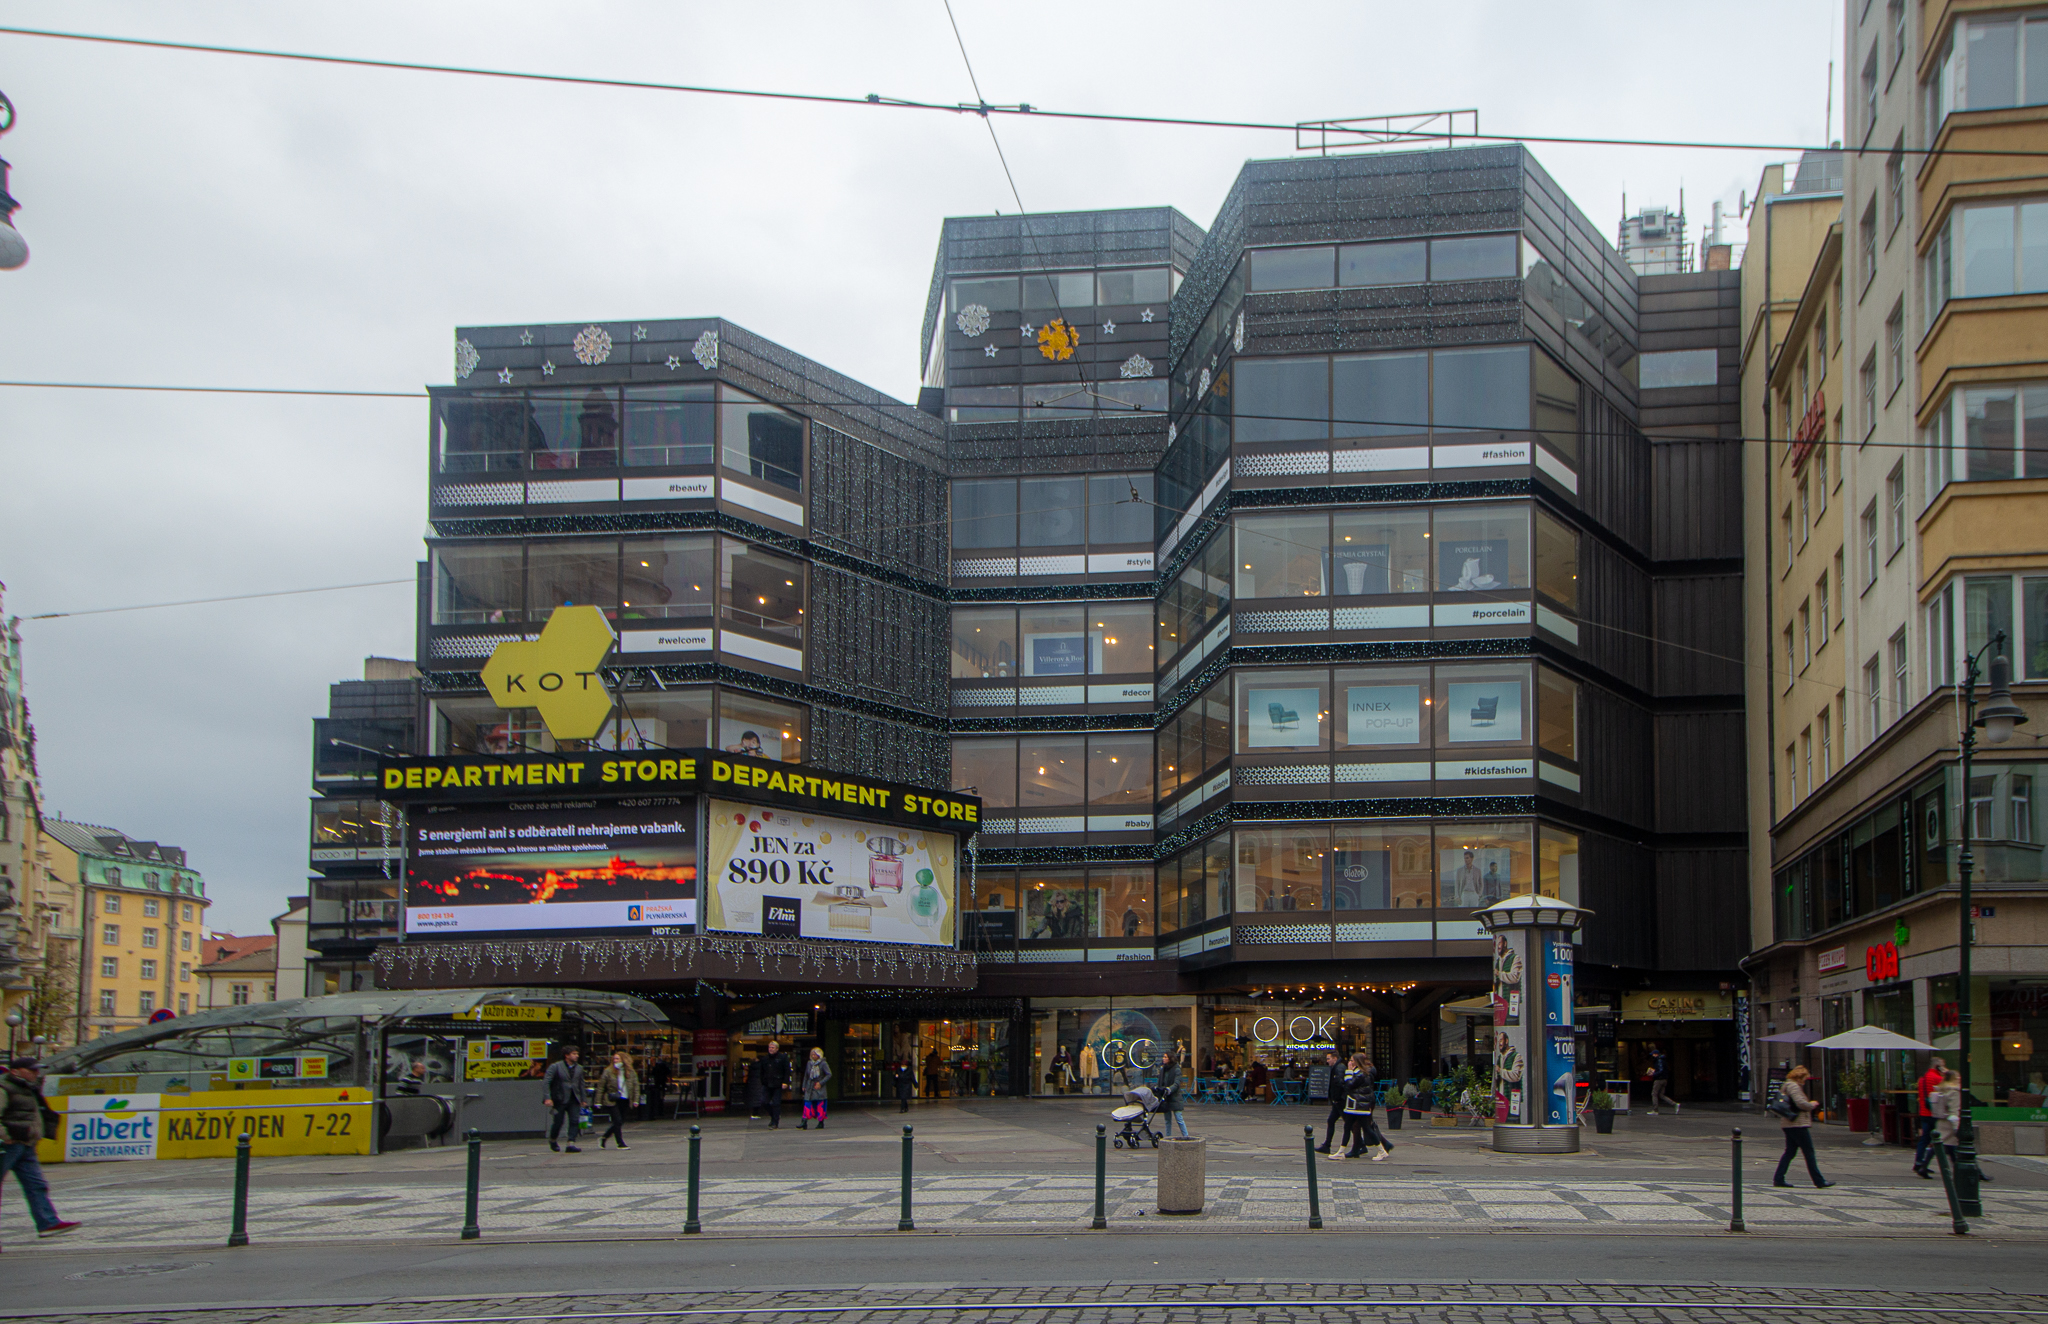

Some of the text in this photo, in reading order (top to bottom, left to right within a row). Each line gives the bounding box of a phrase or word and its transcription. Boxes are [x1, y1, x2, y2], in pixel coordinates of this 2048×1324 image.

[1482, 450, 1525, 459] #fashion
[669, 484, 707, 493] #beauty
[1357, 549, 1386, 557] CRYSTAL
[1455, 546, 1492, 554] PORCELAIN
[1126, 557, 1151, 567] #style
[1472, 609, 1525, 620] #porcelain
[658, 636, 706, 645] #welcome
[1039, 655, 1064, 663] Villeroy
[1122, 689, 1151, 697] #decor
[1352, 702, 1391, 712] INNEX
[1366, 718, 1413, 728] POP-UP
[384, 758, 696, 789] DEPARTMENT STORE
[1464, 766, 1527, 775] #kidsfashion
[712, 760, 977, 822] DEPARTMENT STORE
[509, 803, 534, 811] Chcete
[536, 802, 549, 810] zde
[564, 801, 597, 809] reklamu?
[1125, 820, 1150, 828] #baby
[419, 821, 685, 843] S energiemi ani s odběrateli nehrajeme vabank.
[750, 836, 815, 856] JEN za
[728, 858, 834, 886] 890 Kč
[646, 911, 687, 920] PLYNÁRENSKÁ
[417, 920, 458, 928] www.ppas.cz
[652, 926, 680, 936] HDT.cz
[1648, 997, 1705, 1009] CASINO
[484, 1005, 535, 1018] KAŽDÝ DEN 7-22
[783, 1013, 809, 1032] STREET
[71, 1116, 153, 1141] albert
[168, 1112, 352, 1140] KAŽDÝ DEN 7-22
[70, 1145, 152, 1158] SUPERMARKET
